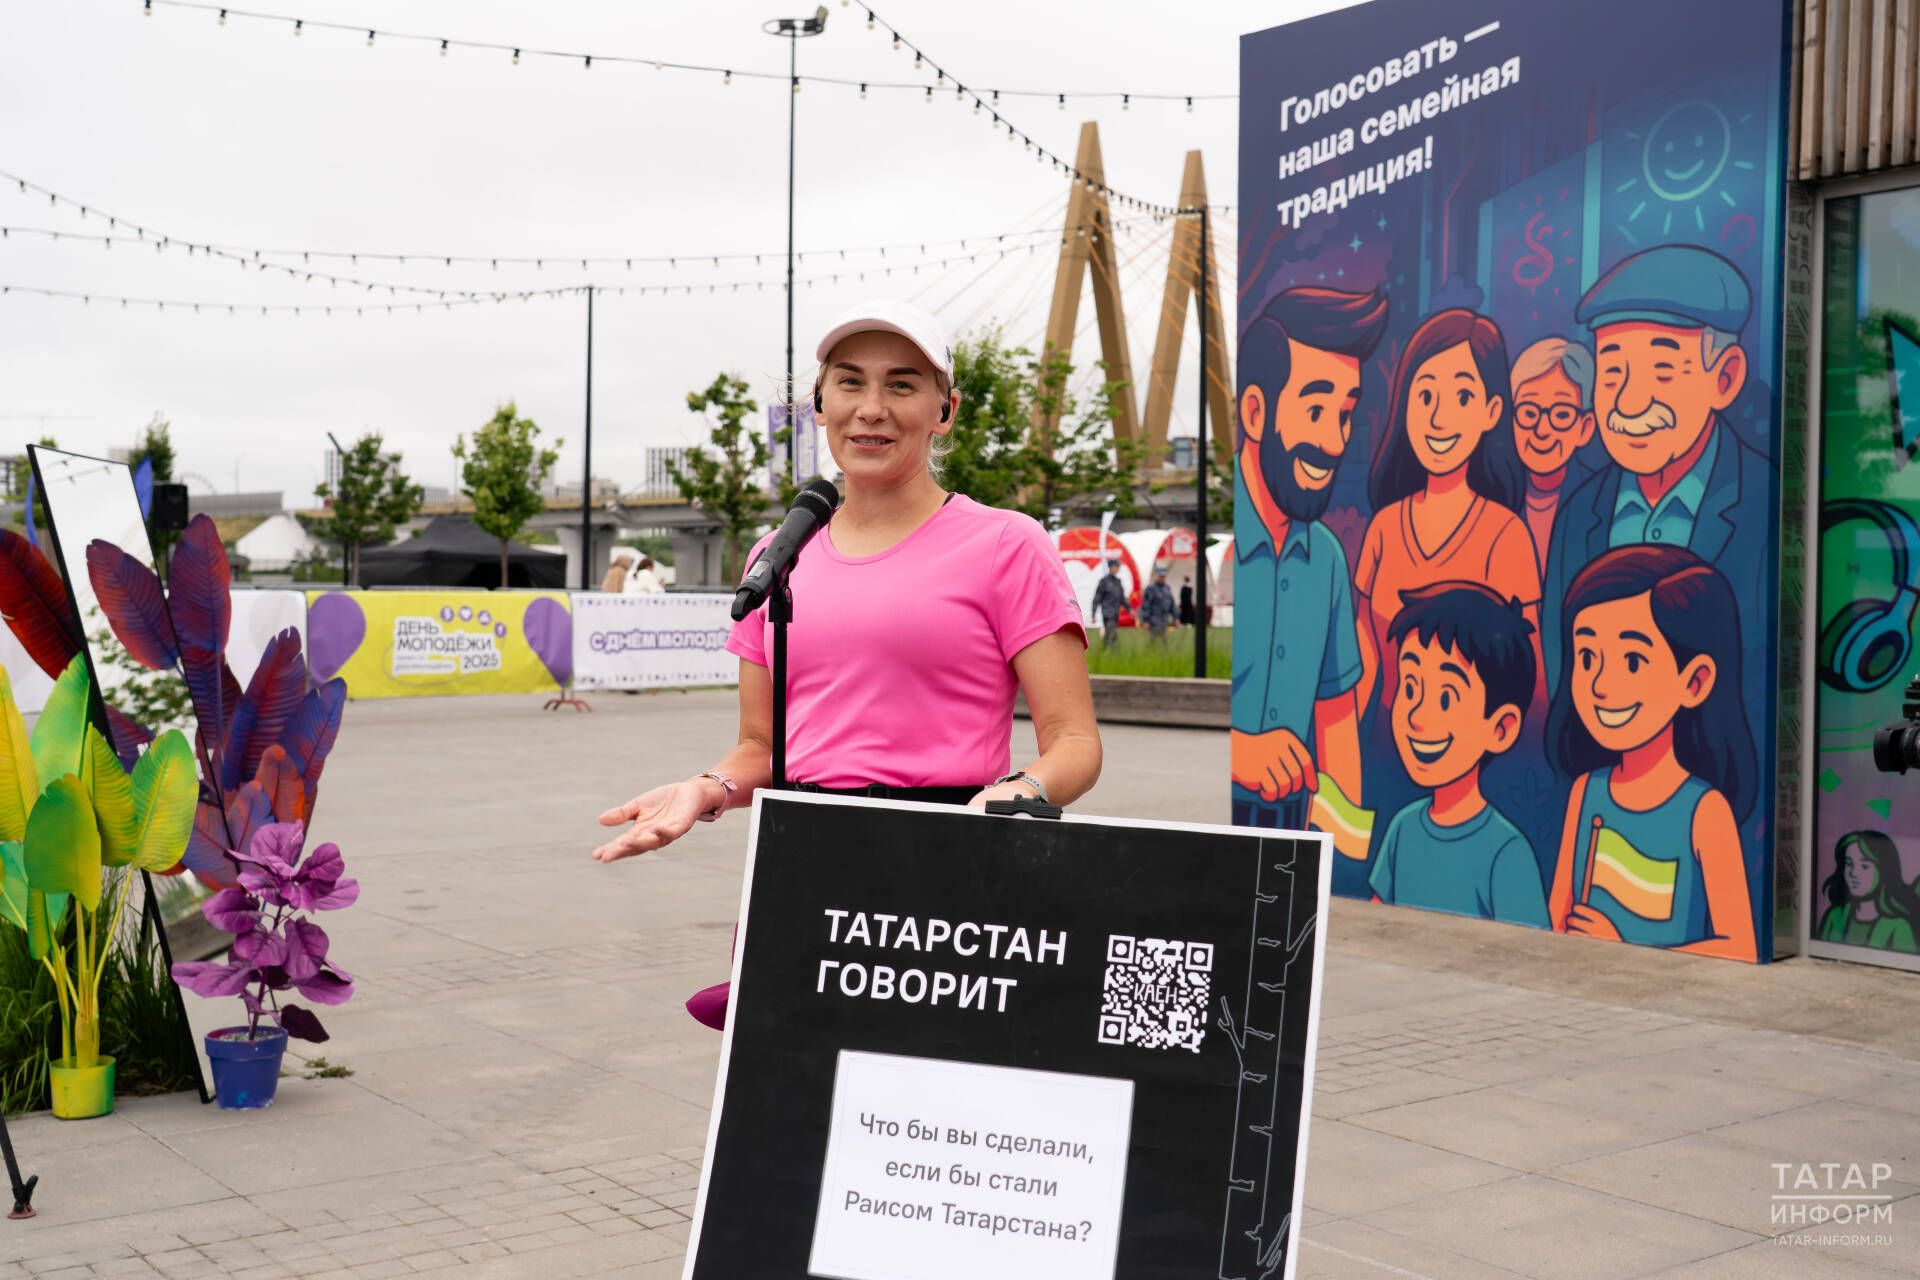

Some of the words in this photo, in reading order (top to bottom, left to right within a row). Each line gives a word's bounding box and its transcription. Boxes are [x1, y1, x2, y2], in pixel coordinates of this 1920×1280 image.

[1280, 36, 1458, 132] Голосовать
[1278, 127, 1355, 180] наша
[1360, 56, 1521, 145] семейная
[1277, 135, 1434, 230] традиция!
[397, 621, 440, 636] ДЕНЬ
[397, 634, 493, 653] МОЛОДЁЖИ
[589, 630, 604, 651] С
[603, 628, 656, 654] ДНЁМ
[463, 653, 499, 669] 2025
[824, 908, 1067, 965] ТАТАРСТАН
[816, 959, 1018, 1013] ГОВОРИТ
[859, 1112, 900, 1137] Что
[906, 1119, 939, 1142] бы
[946, 1127, 977, 1146] вы
[985, 1132, 1095, 1164] сделали,
[885, 1160, 941, 1182] если
[949, 1163, 981, 1187] бы
[988, 1172, 1058, 1197] стали
[844, 1190, 933, 1222] Раисом
[940, 1202, 1093, 1242] Татарстана?
